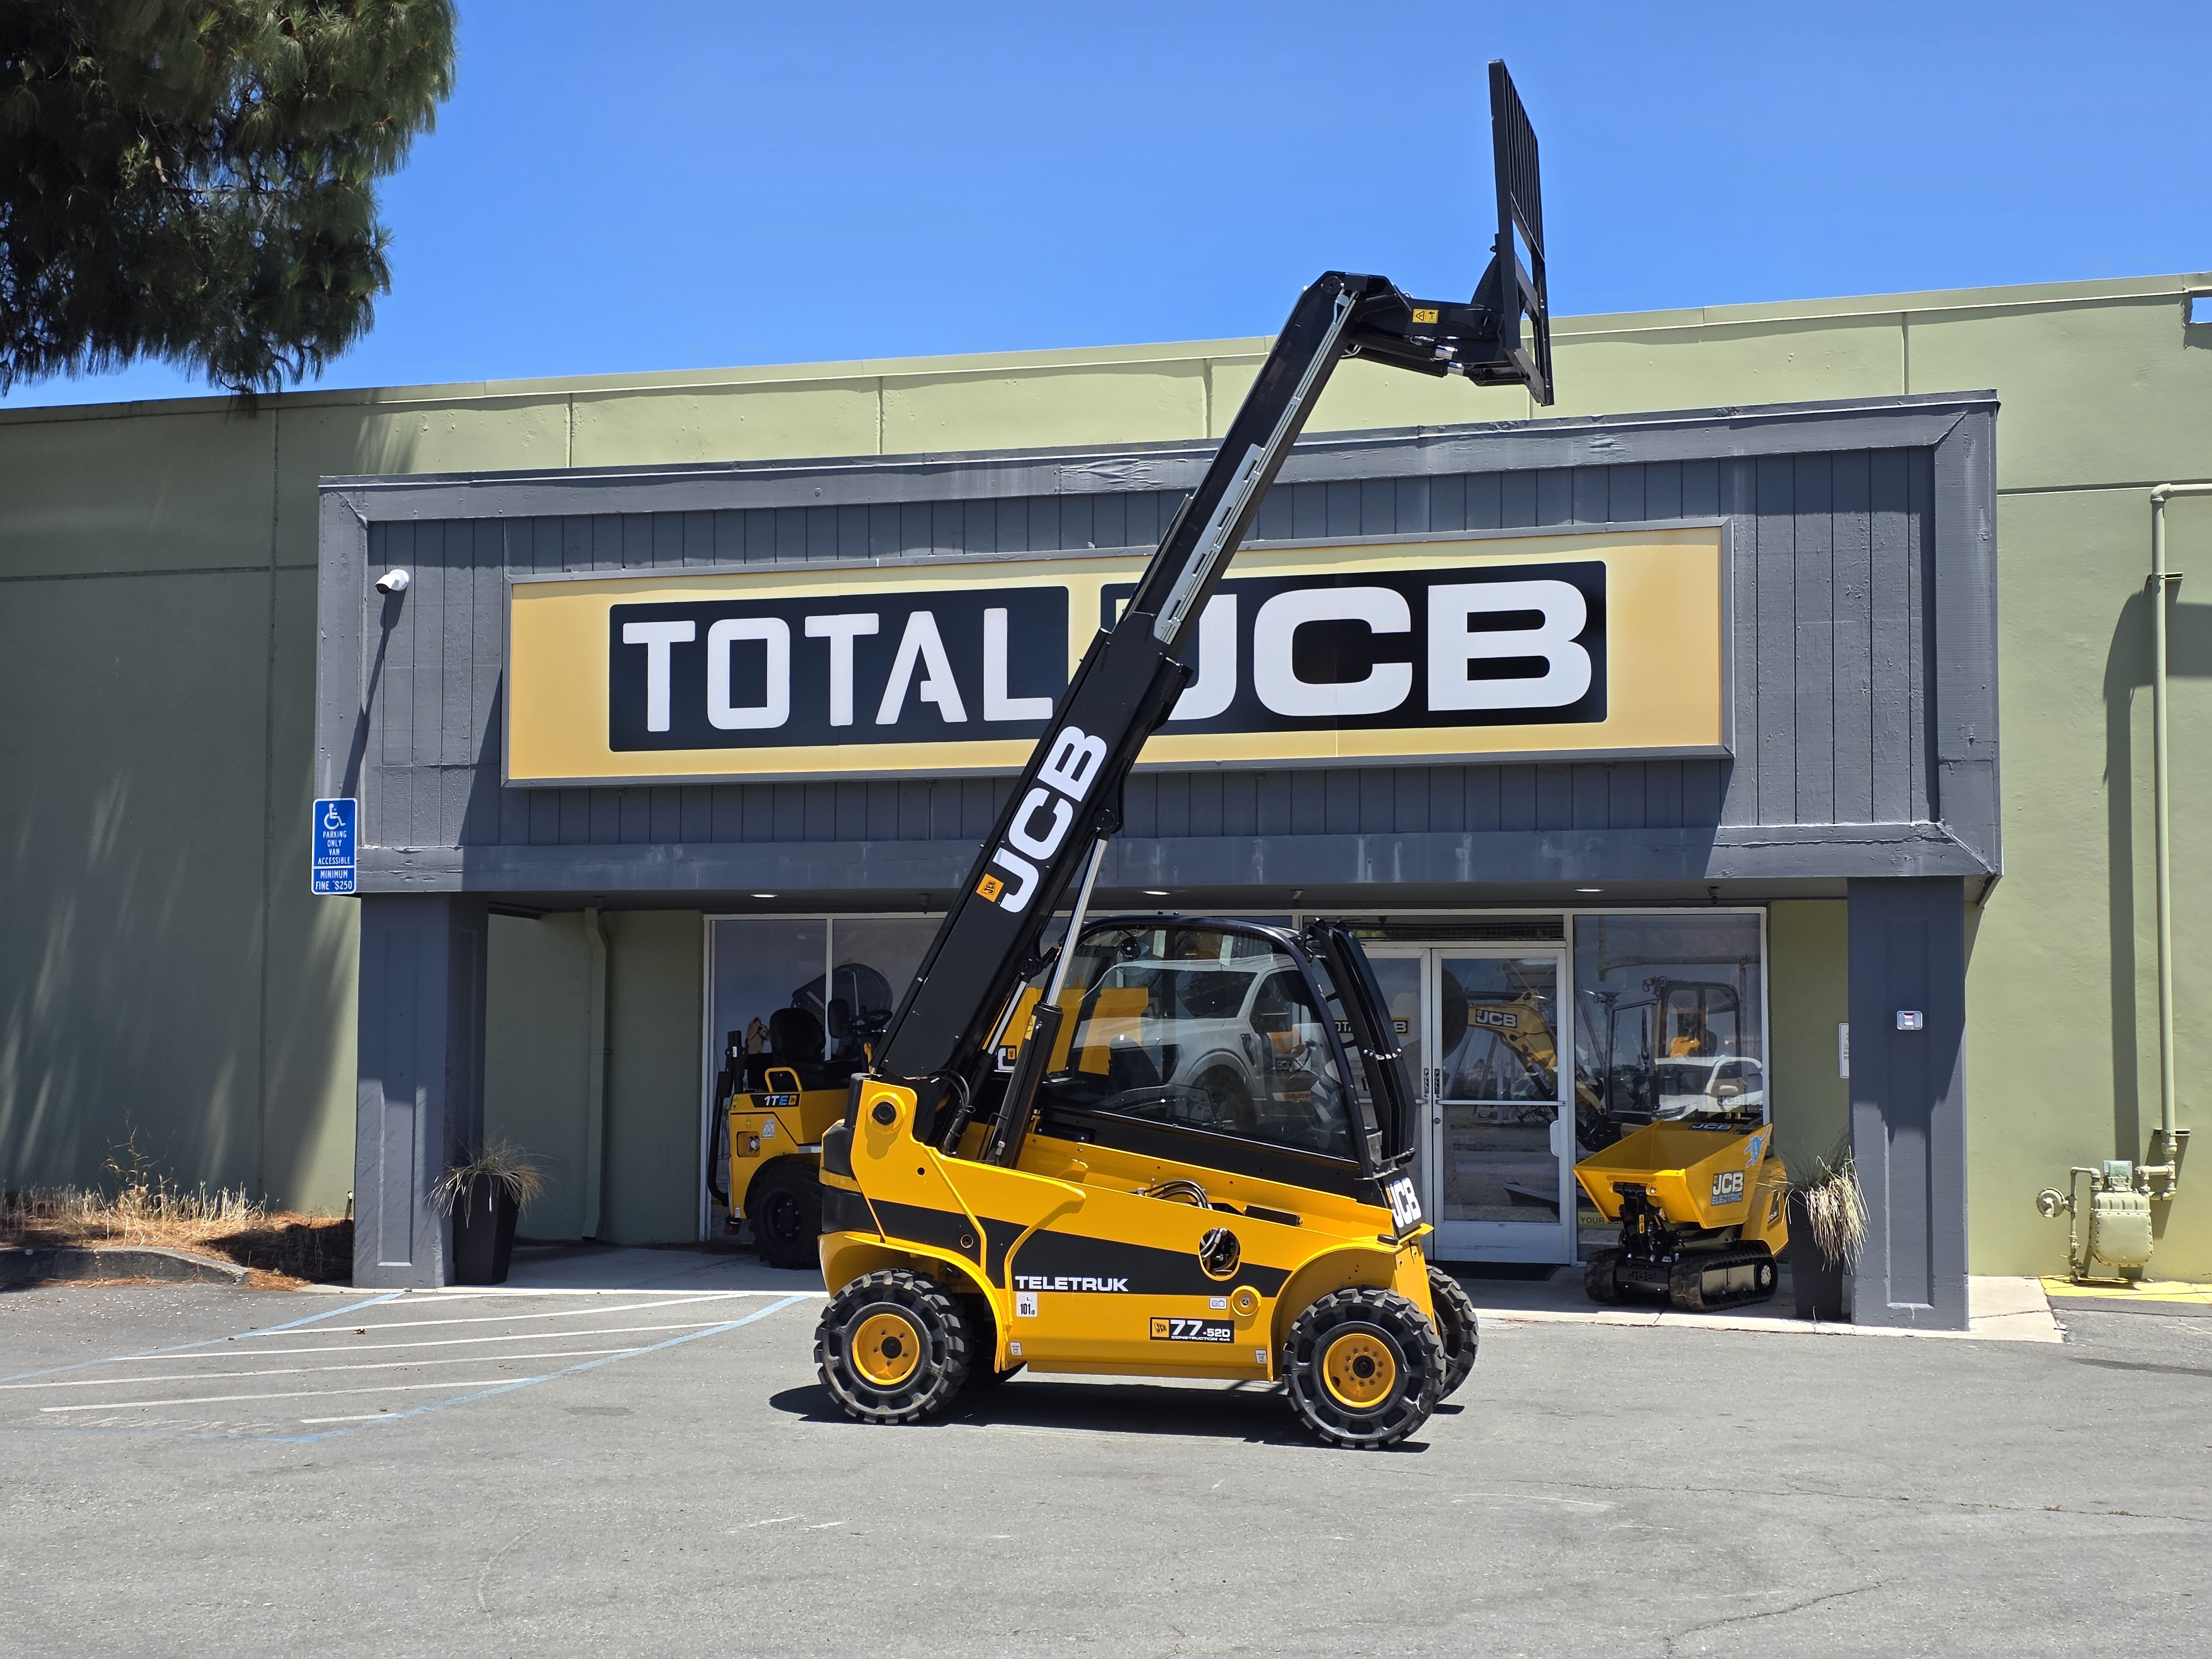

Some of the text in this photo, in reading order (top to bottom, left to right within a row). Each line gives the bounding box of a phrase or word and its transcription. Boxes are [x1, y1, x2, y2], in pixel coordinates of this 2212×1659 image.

[623, 608, 1053, 732] TOTAL
[992, 726, 1107, 912] JCB
[322, 830, 347, 838] PARKING
[317, 857, 351, 865] ACCESSIBLE
[320, 869, 348, 879] MINIMUM
[315, 880, 352, 890] FINE $250
[984, 881, 995, 894] JCB
[1477, 1011, 1516, 1027] JCB
[764, 1095, 789, 1106] 1TE
[1713, 1172, 1744, 1195] JCB
[1389, 1177, 1422, 1228] JCB
[1712, 1192, 1743, 1205] ELECTRIC
[1015, 1276, 1129, 1292] TELETRUK
